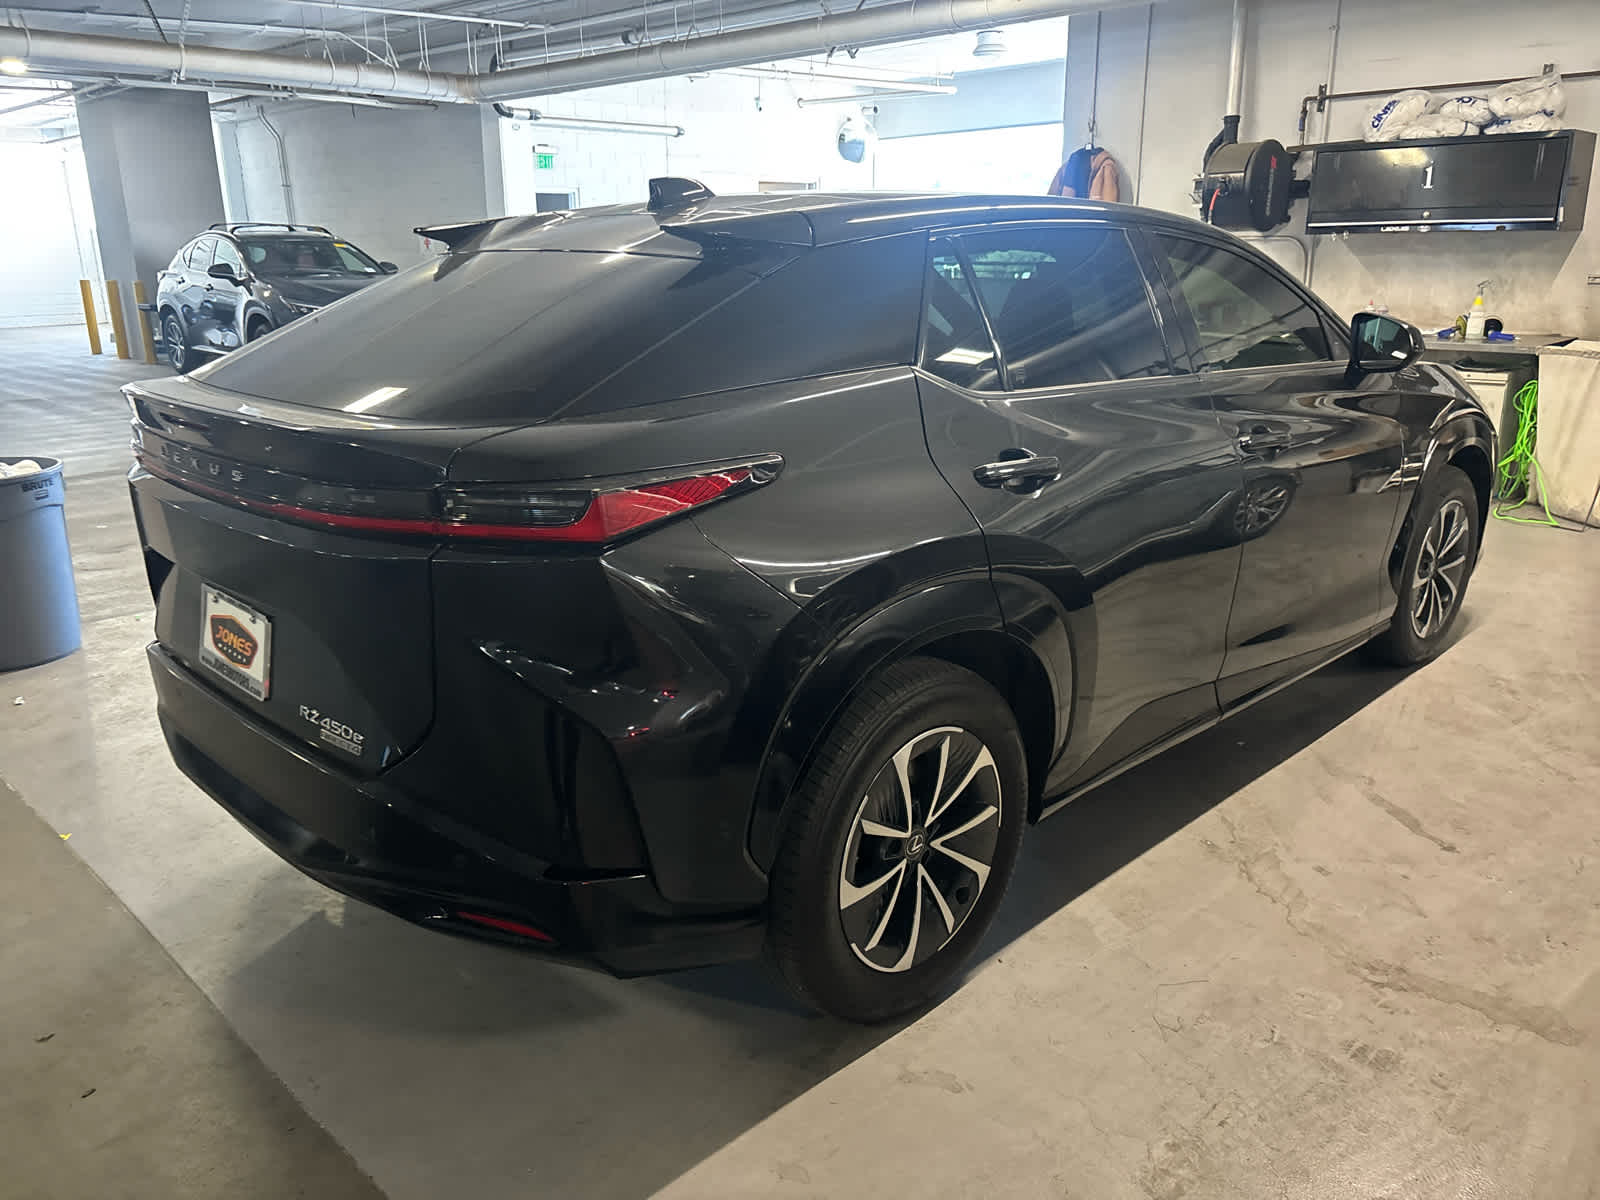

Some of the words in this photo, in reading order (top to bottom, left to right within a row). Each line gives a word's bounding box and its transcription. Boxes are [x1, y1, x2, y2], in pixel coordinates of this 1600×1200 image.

[1421, 166, 1435, 189] 1
[161, 443, 242, 482] LEXUS
[215, 625, 253, 656] JONES
